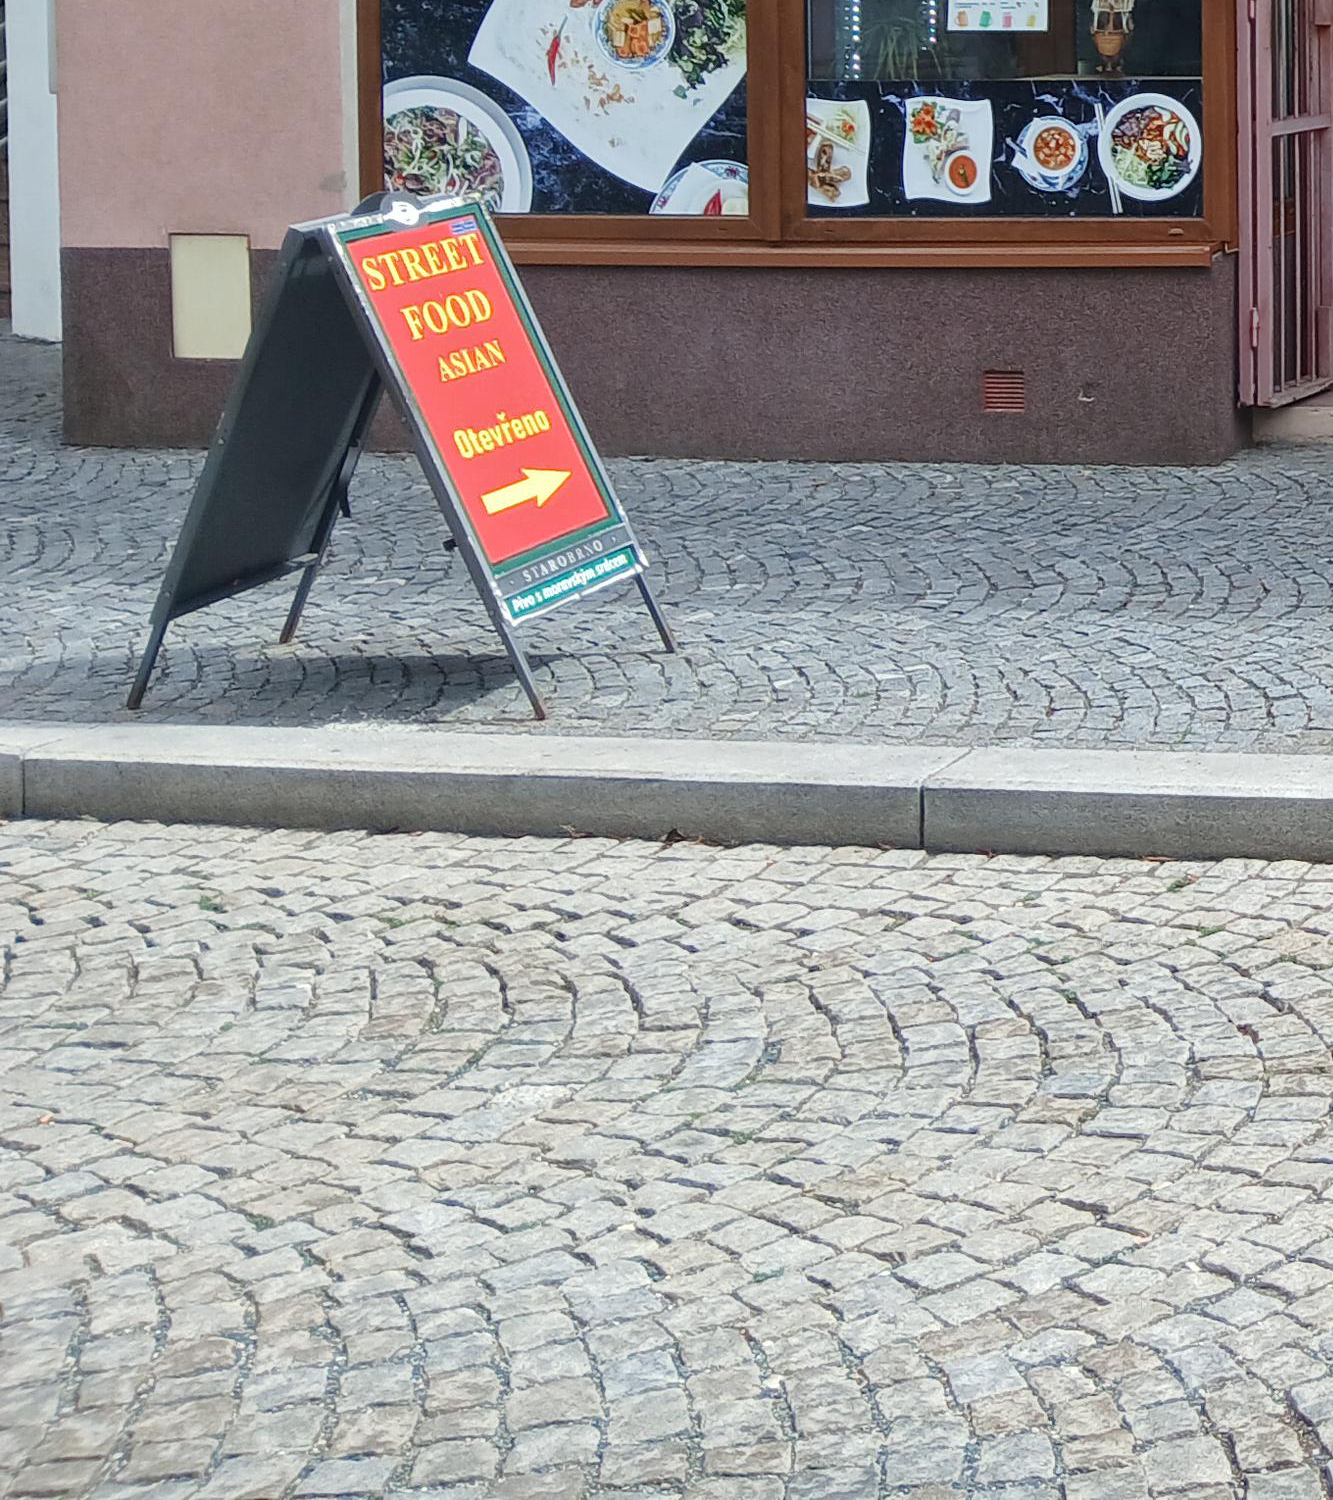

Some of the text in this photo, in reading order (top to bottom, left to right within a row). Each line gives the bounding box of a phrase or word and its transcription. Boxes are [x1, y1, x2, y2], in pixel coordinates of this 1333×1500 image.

[362, 234, 484, 290] STREET
[400, 290, 493, 340] FOOD
[438, 340, 506, 382] ASIAN
[453, 410, 550, 460] Otevřeno
[522, 539, 603, 583] STAROBRNO
[512, 594, 535, 611] Pivo
